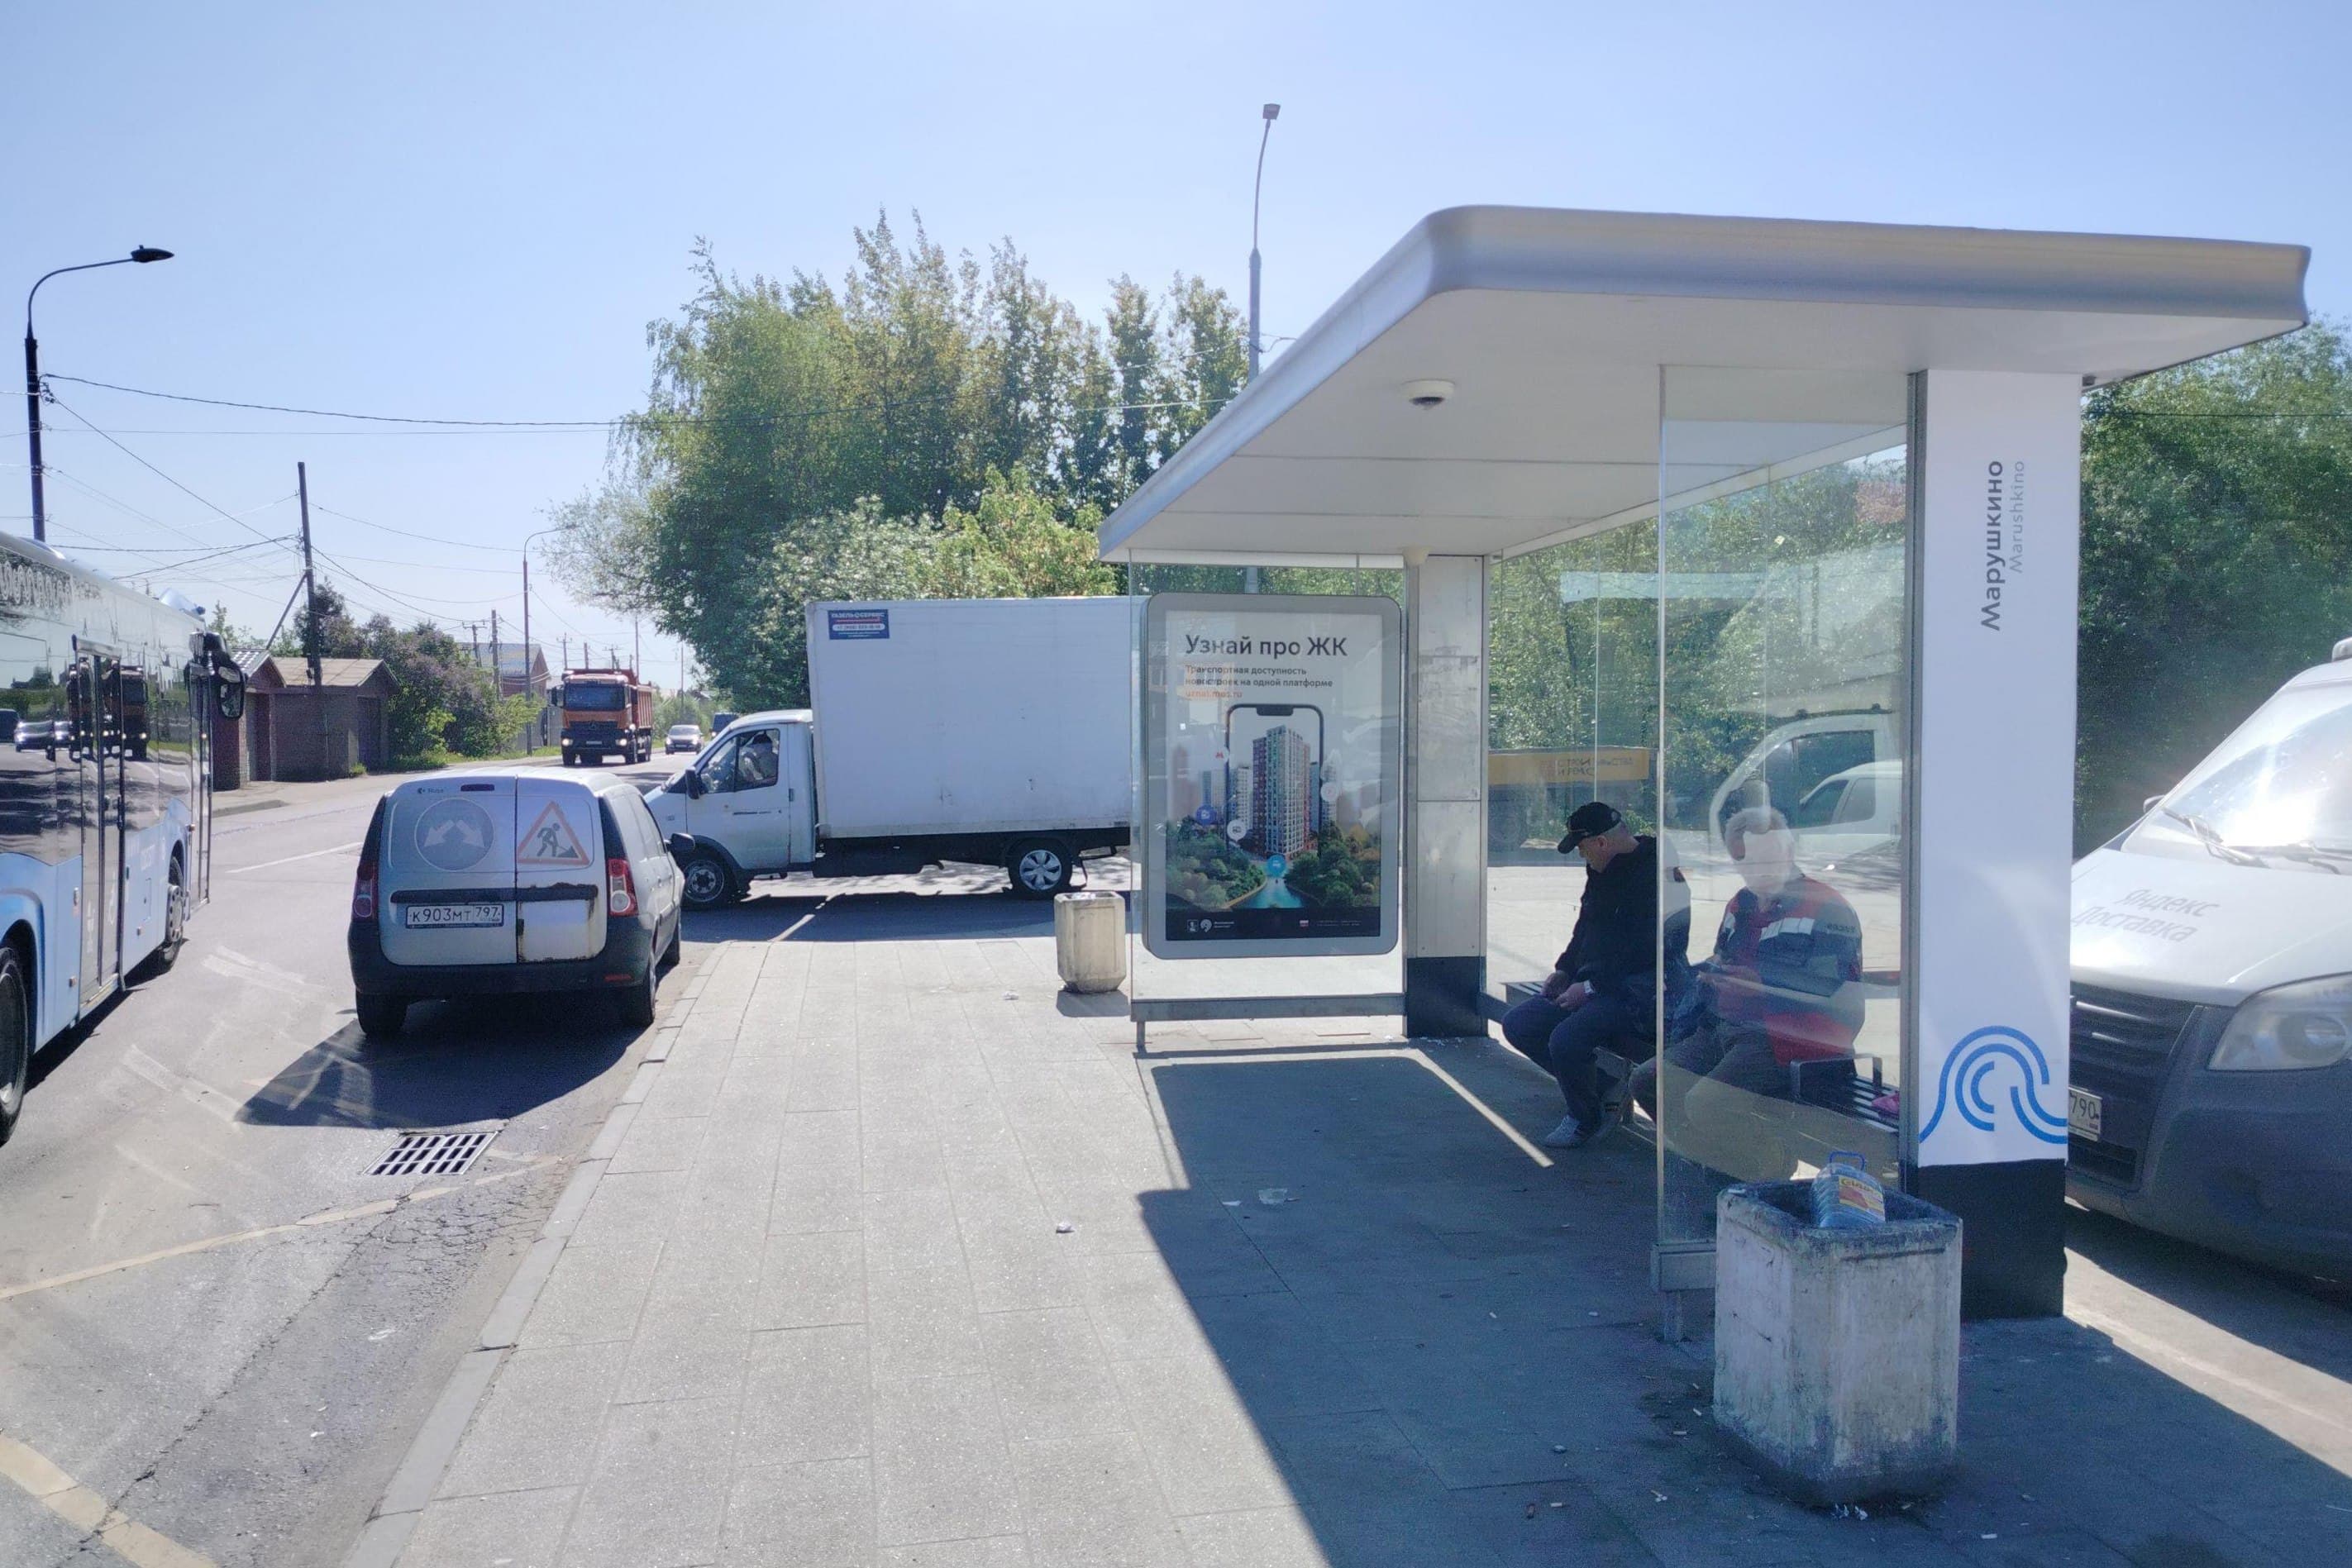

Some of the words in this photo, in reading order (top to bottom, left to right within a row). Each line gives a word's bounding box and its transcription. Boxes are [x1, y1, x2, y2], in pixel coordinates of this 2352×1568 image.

[2009, 460, 2025, 574] Marushkino
[1981, 460, 2006, 631] Марушкино
[1186, 634, 1252, 655] Узнай
[1259, 641, 1301, 660] про
[1307, 636, 1348, 656] ЖК
[1186, 665, 1249, 675] Транспортная
[1251, 665, 1307, 675] доступность
[1253, 678, 1281, 688] одной
[1283, 678, 1333, 689] платформе
[475, 906, 499, 917] 797
[2114, 889, 2221, 917] Яндекс
[2071, 906, 2199, 942] Доставка
[2069, 1090, 2097, 1119] 790
